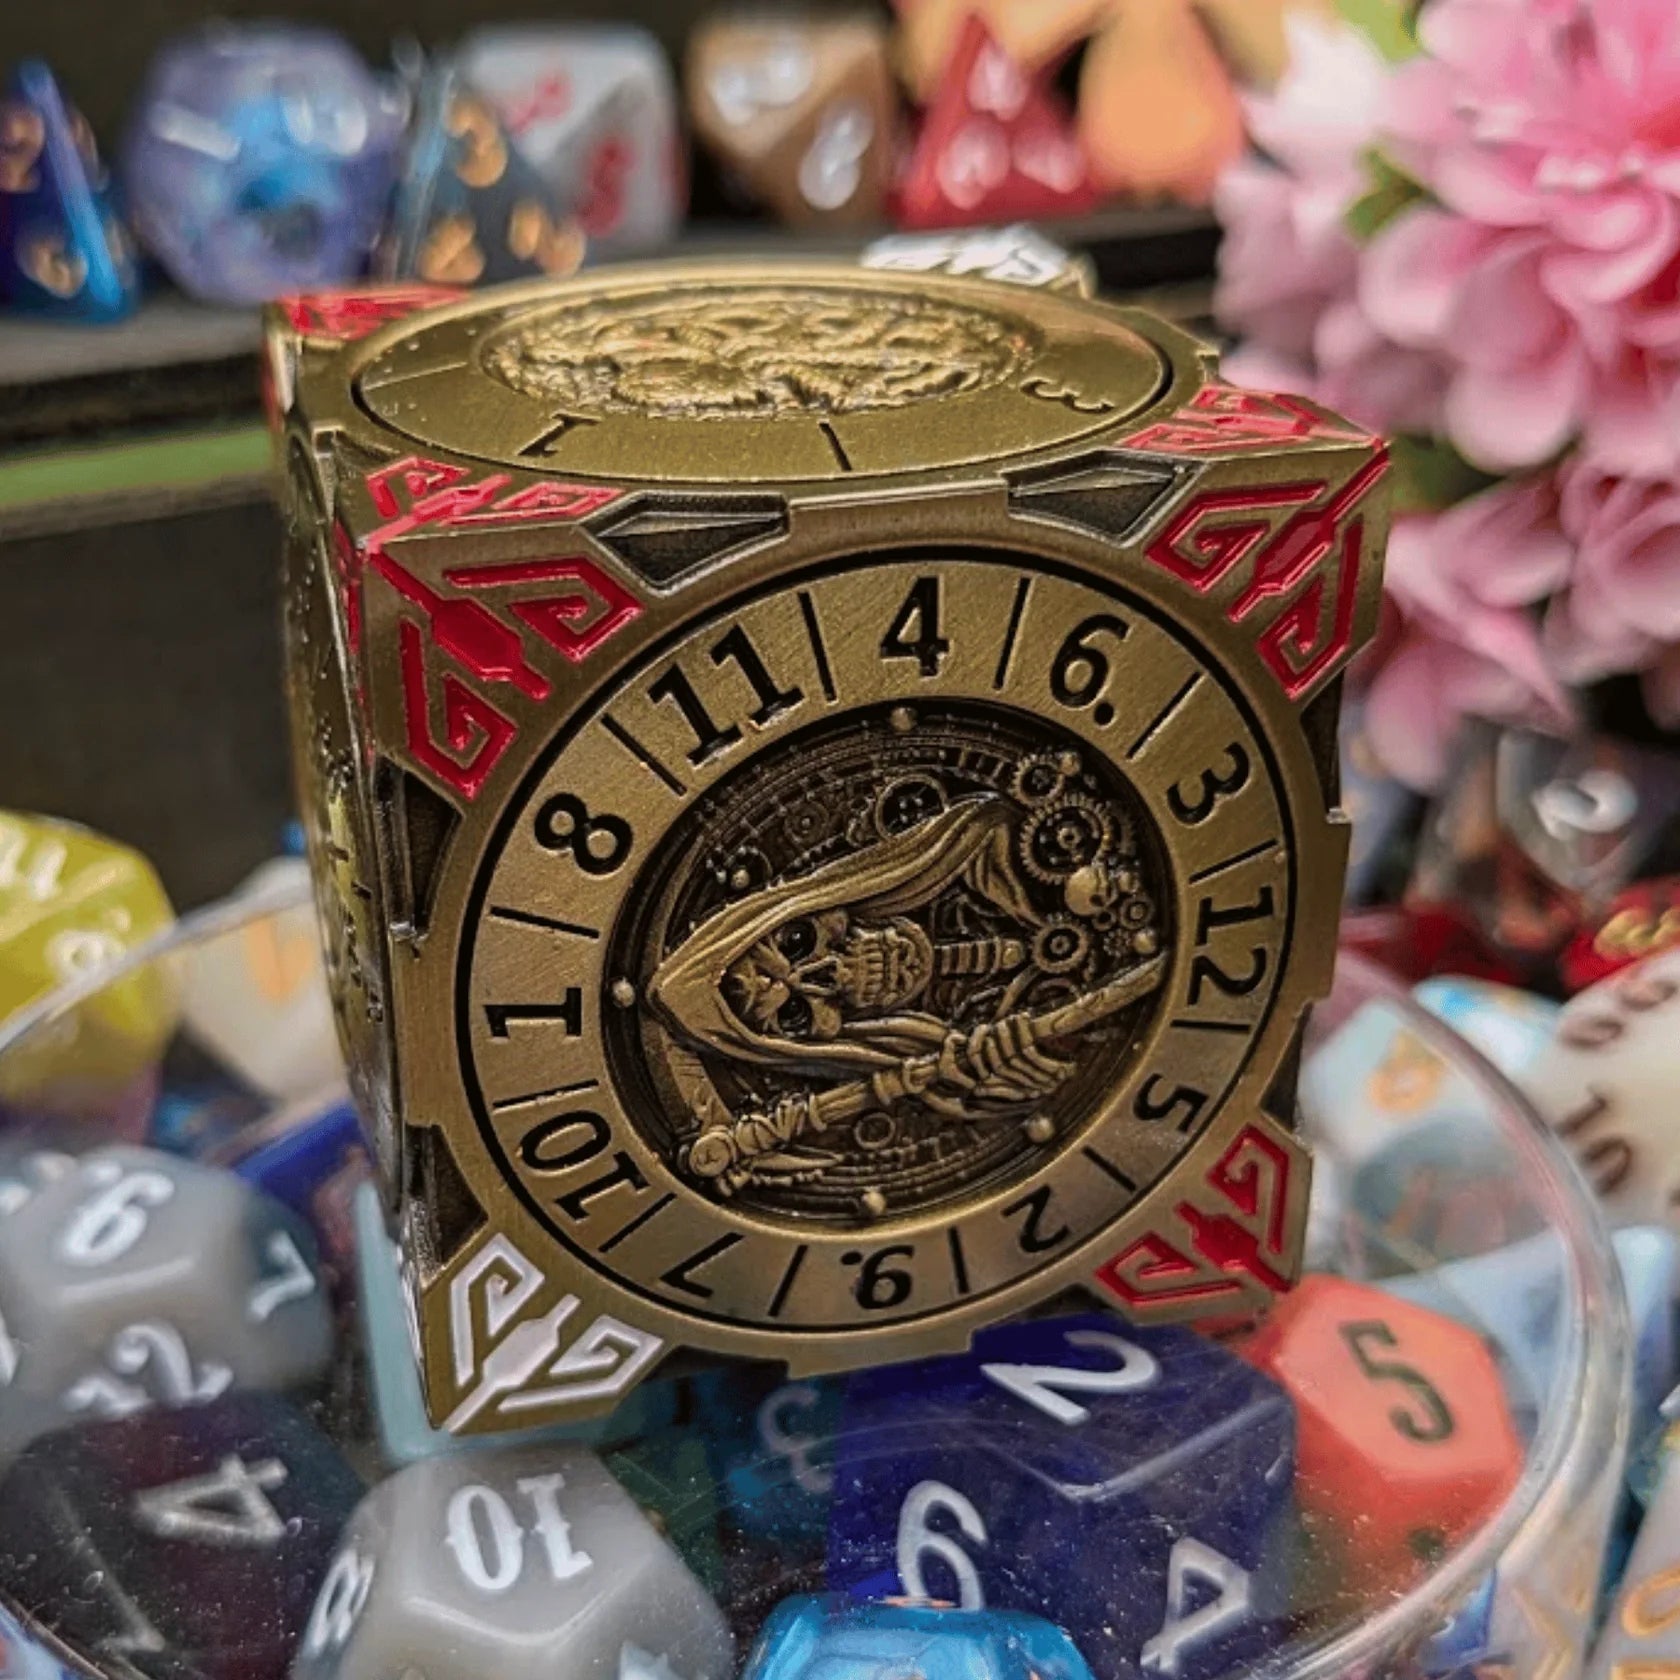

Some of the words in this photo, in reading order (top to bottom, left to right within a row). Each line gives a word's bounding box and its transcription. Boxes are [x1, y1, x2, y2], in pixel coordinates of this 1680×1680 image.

[879, 576, 950, 677] 4
[647, 624, 805, 767] 11
[1166, 741, 1252, 826] 3
[533, 792, 633, 876] 8
[1186, 885, 1274, 1006] 12
[483, 987, 583, 1039] 1
[1133, 1073, 1208, 1133] 5
[521, 1110, 651, 1223] 10
[659, 1232, 744, 1298] 7
[1003, 1185, 1071, 1254] 2
[980, 1330, 1161, 1426] 2
[1337, 1318, 1454, 1445] 5
[446, 1472, 594, 1592] 10
